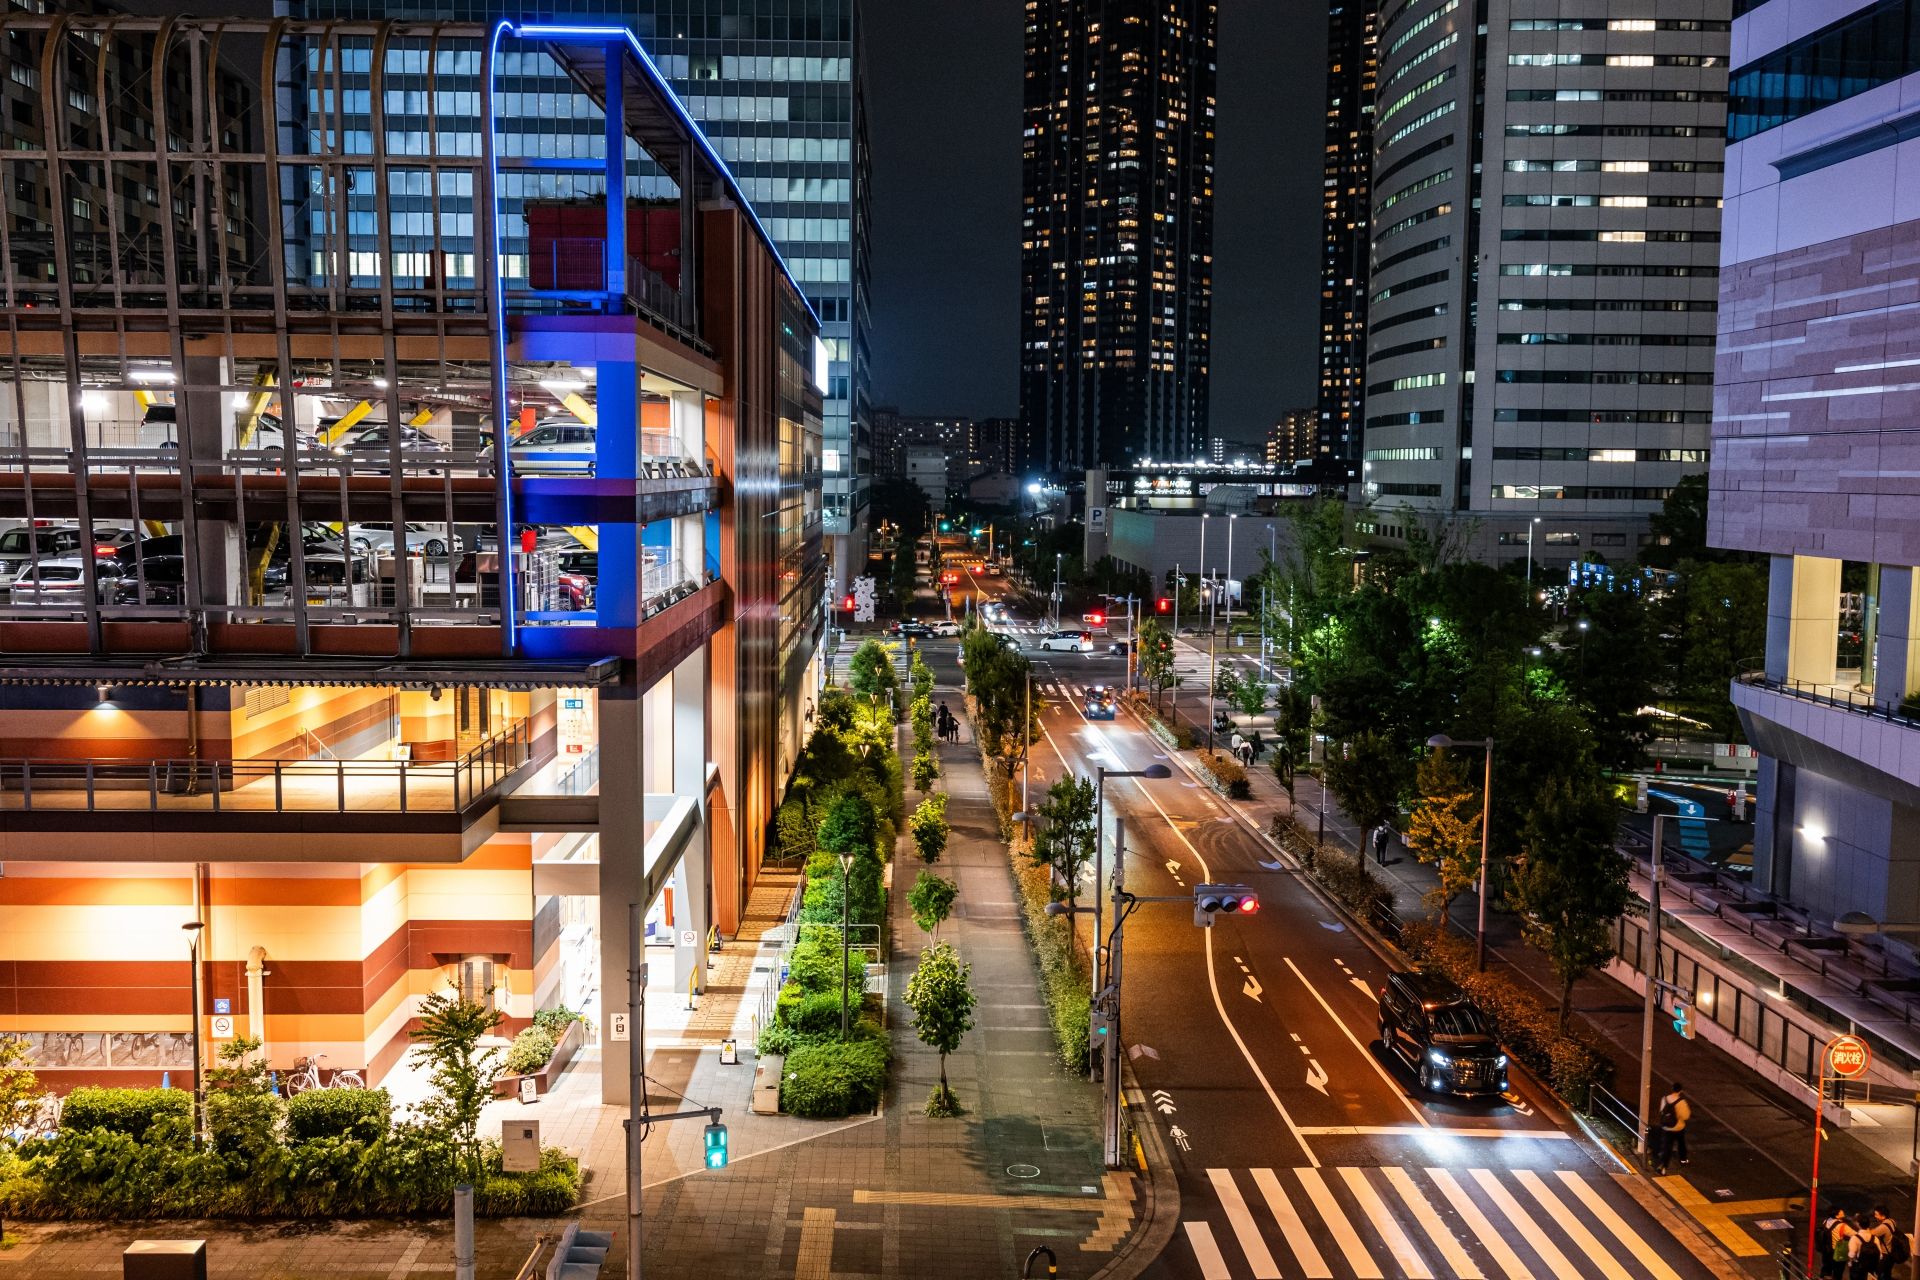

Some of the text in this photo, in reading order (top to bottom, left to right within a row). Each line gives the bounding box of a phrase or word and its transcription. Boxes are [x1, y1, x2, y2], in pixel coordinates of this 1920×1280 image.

[1093, 509, 1102, 521] P
[1833, 1051, 1862, 1065] 消火栓
